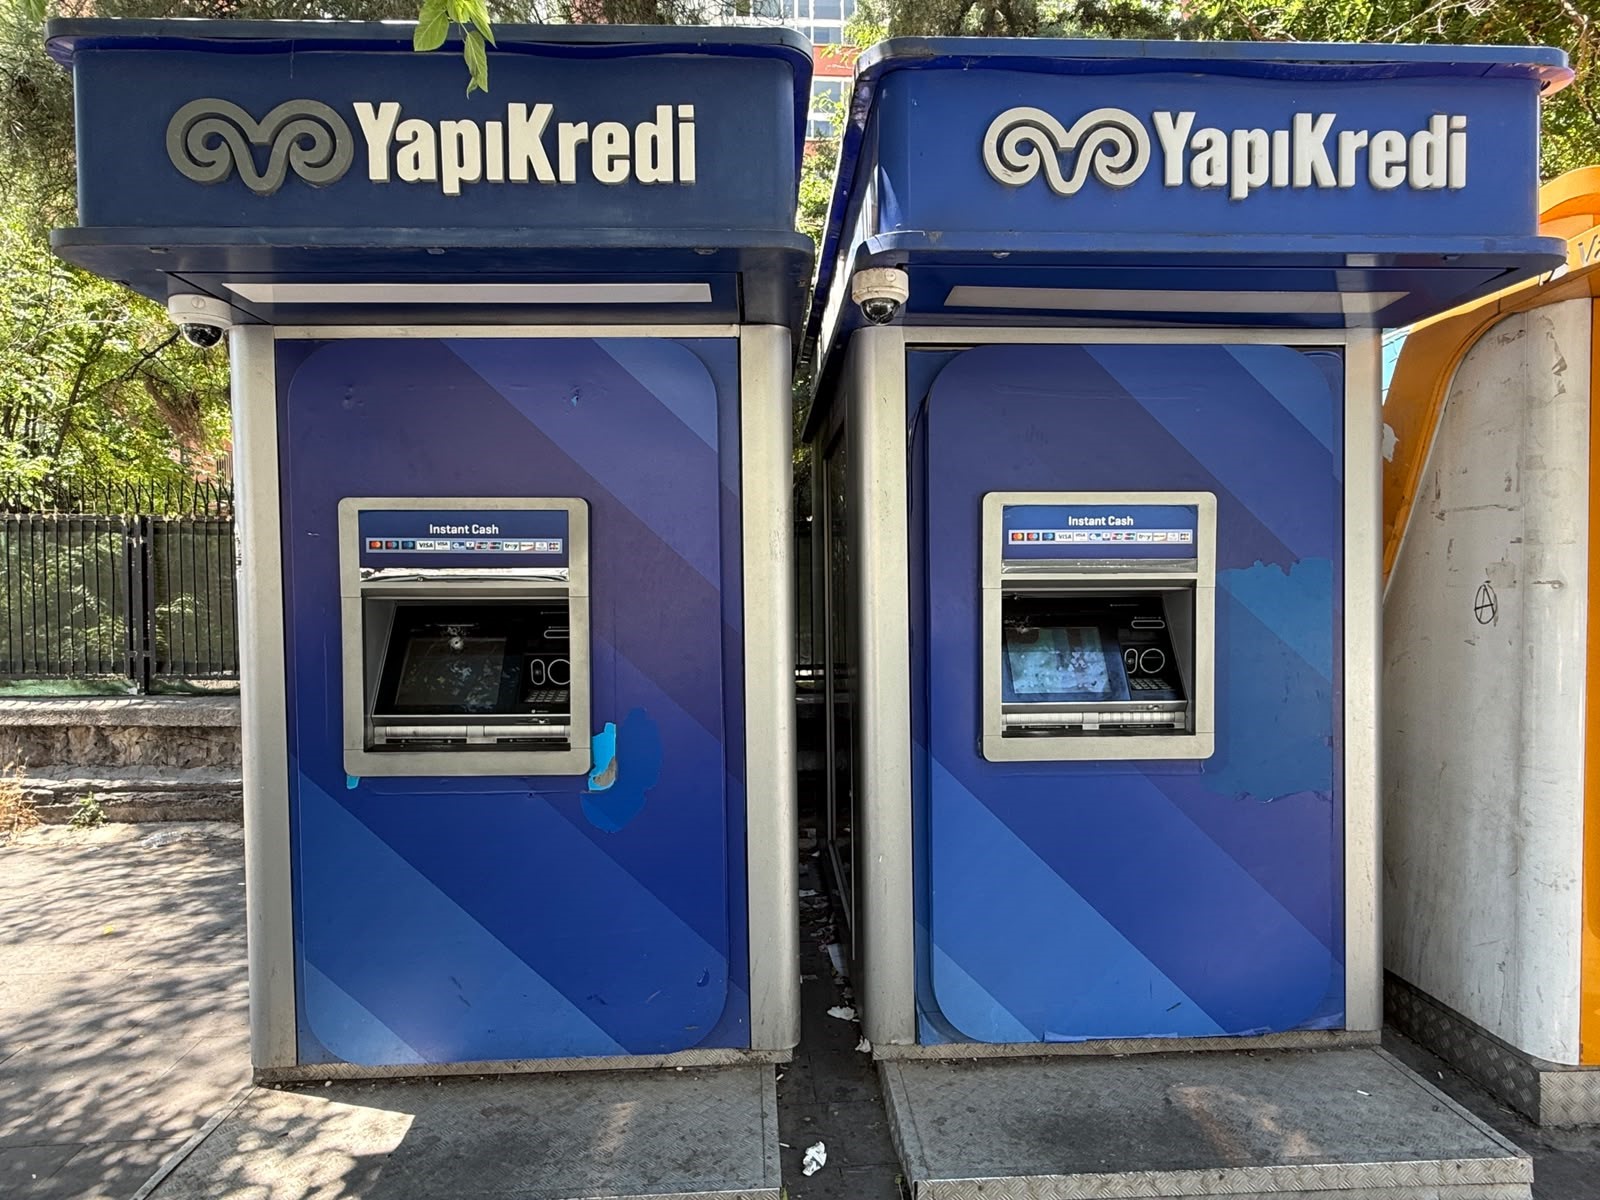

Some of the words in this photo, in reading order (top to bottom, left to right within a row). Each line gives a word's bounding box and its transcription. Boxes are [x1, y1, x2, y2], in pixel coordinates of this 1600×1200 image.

[1068, 515, 1106, 526] Instant
[1108, 515, 1134, 526] Cash
[429, 523, 470, 535] Instant
[471, 523, 499, 535] Cash
